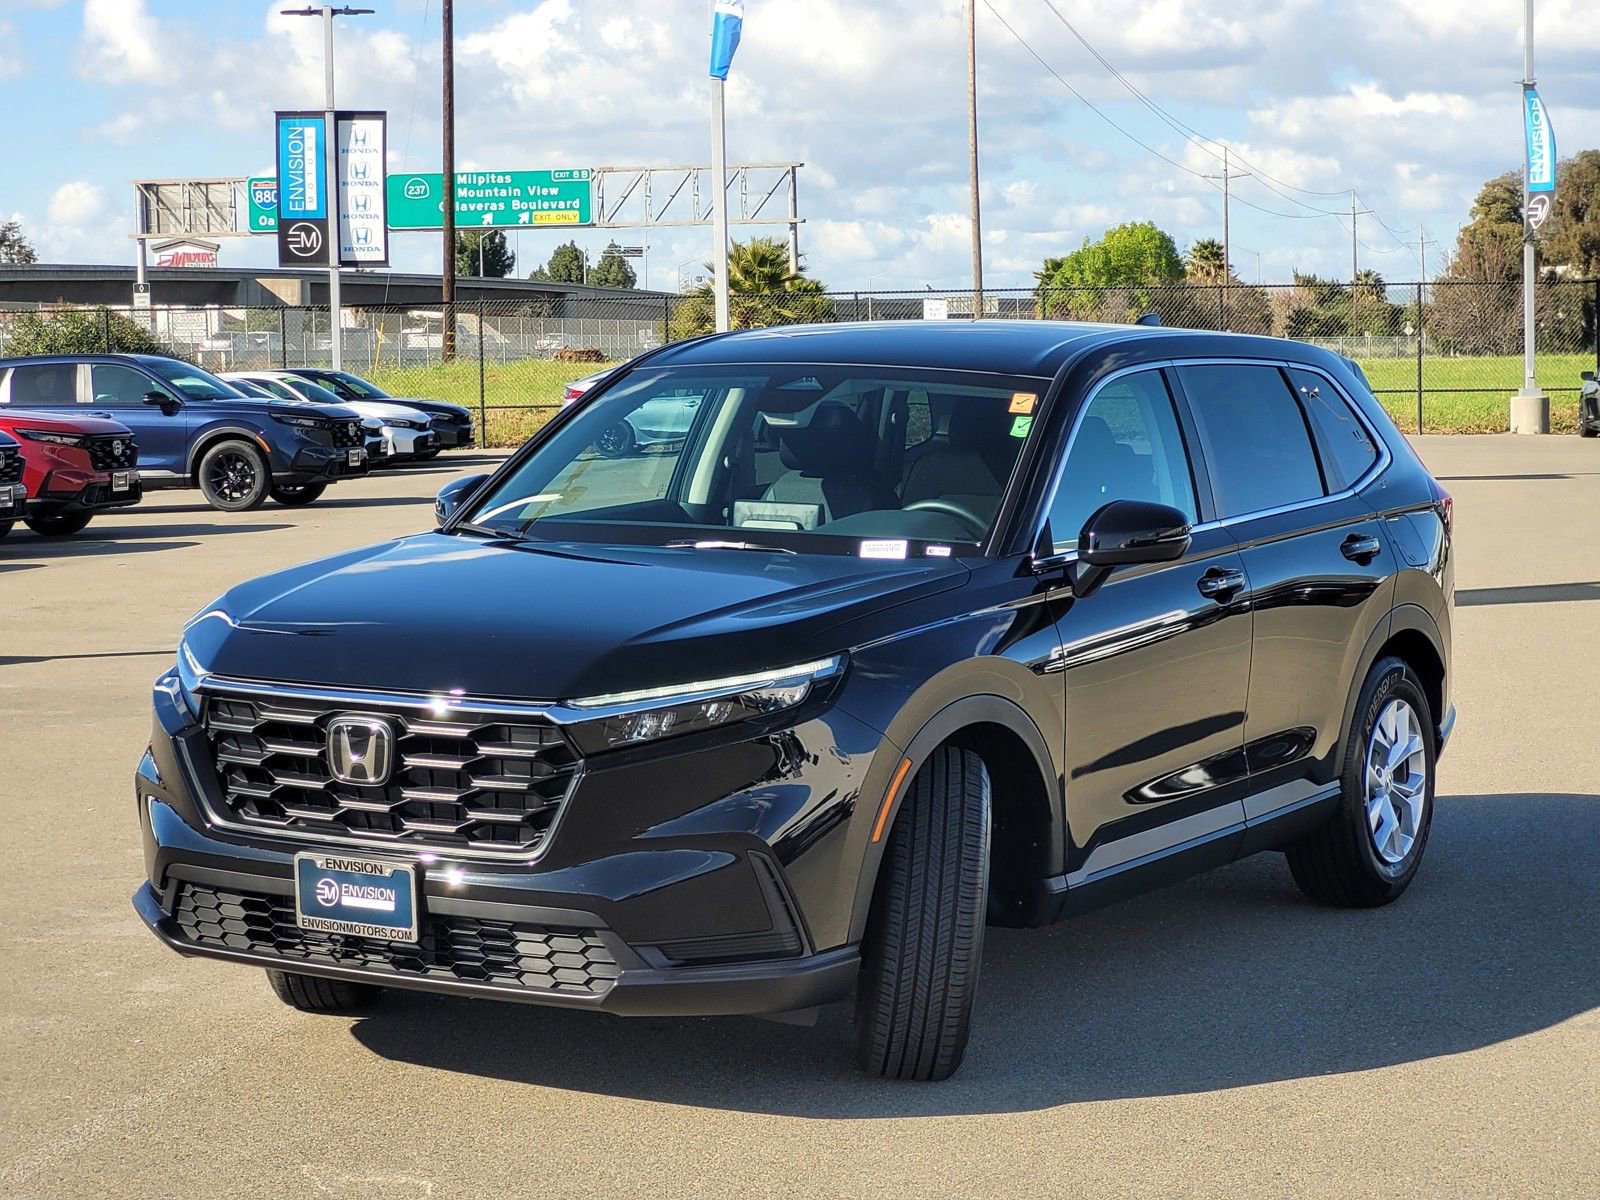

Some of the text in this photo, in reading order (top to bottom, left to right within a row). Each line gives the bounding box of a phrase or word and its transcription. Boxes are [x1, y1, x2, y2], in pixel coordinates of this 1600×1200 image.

[288, 126, 305, 211] ENVISION
[307, 135, 315, 204] MOTORS
[457, 173, 512, 187] Milpitas
[407, 185, 426, 195] 237
[457, 185, 559, 198] Mountain View
[438, 198, 580, 212] Claveras Boulevard
[555, 213, 578, 221] ONLY
[1365, 675, 1390, 735] KINERGY
[325, 857, 384, 875] ENVISION
[341, 883, 396, 901] ENVISION
[301, 917, 413, 941] ENVISIONMOTORS.COM
